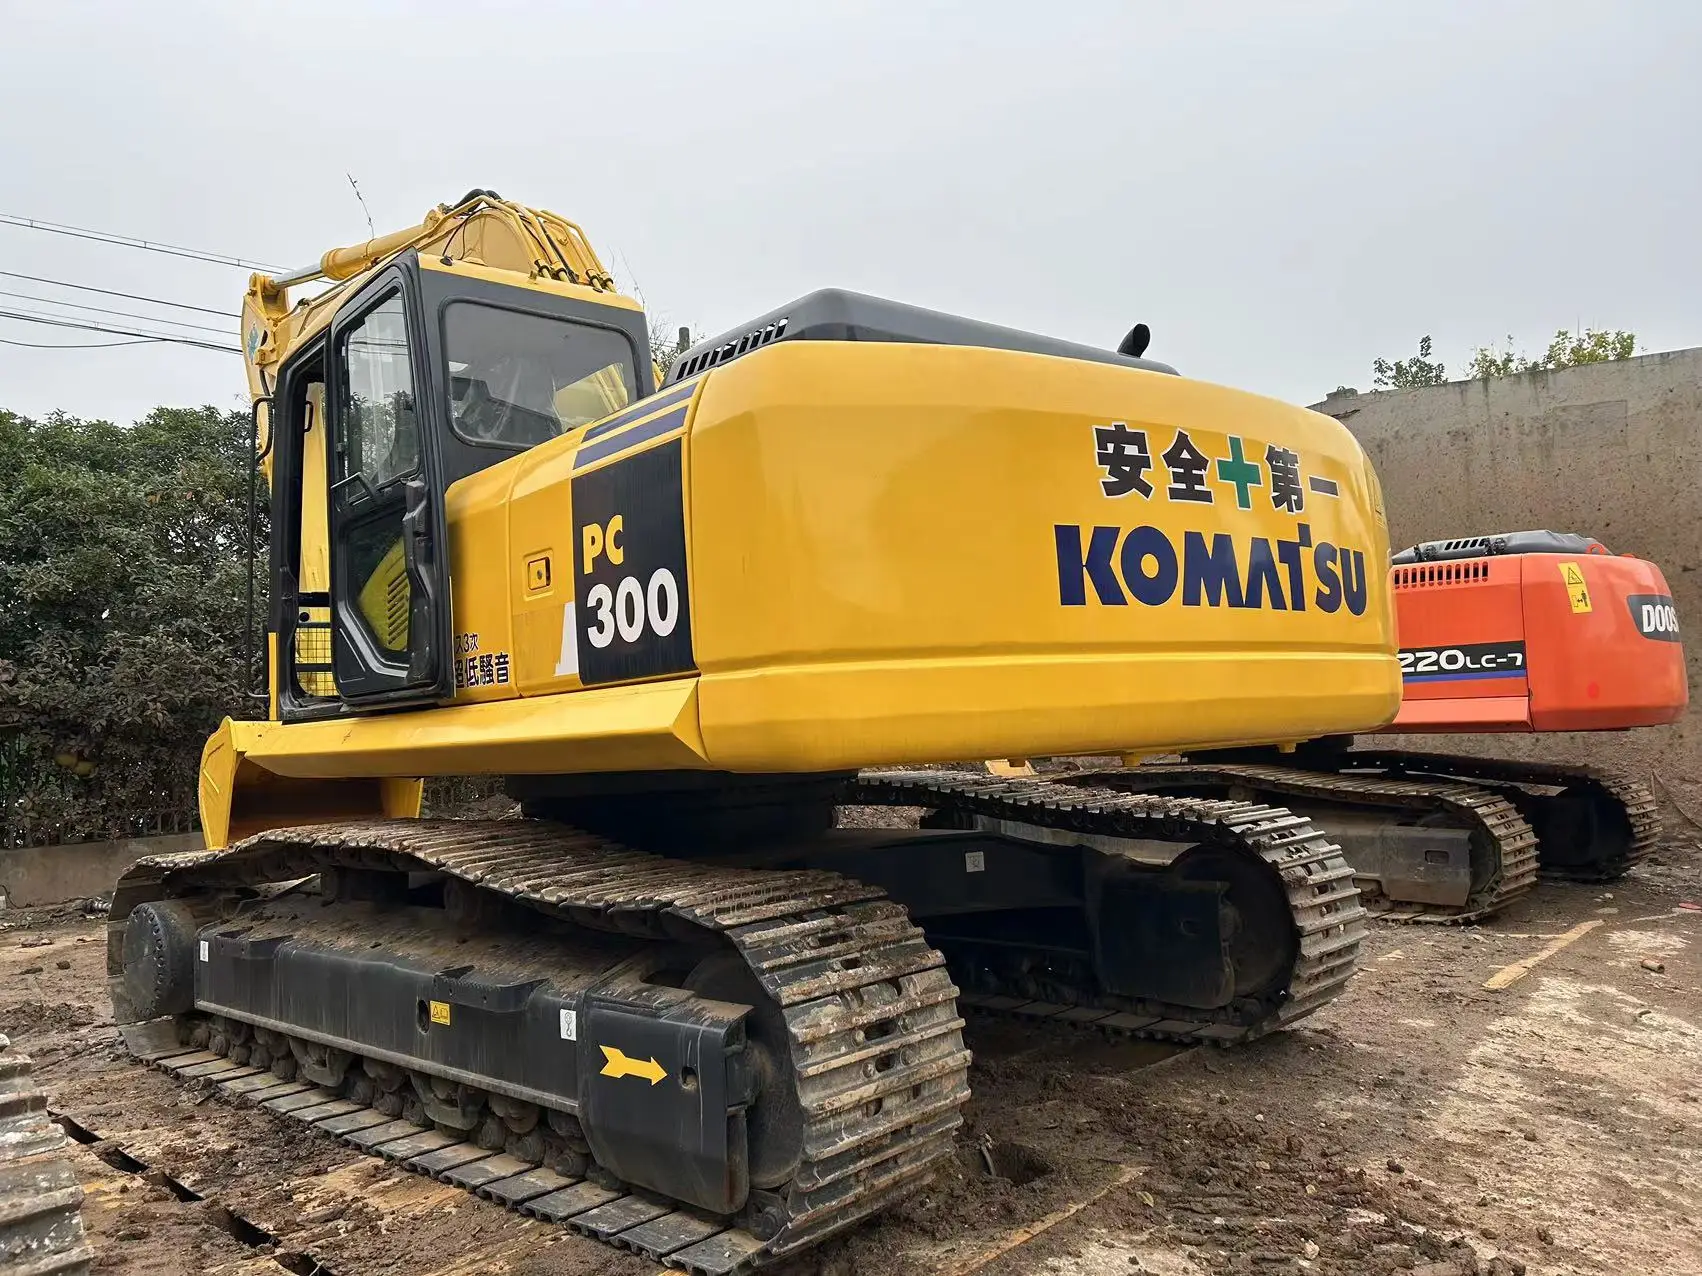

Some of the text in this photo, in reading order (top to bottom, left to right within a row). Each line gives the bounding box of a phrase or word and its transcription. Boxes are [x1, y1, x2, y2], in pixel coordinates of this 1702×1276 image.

[582, 515, 625, 574] PC
[1054, 523, 1368, 616] KOMATSU
[586, 567, 679, 649] 300
